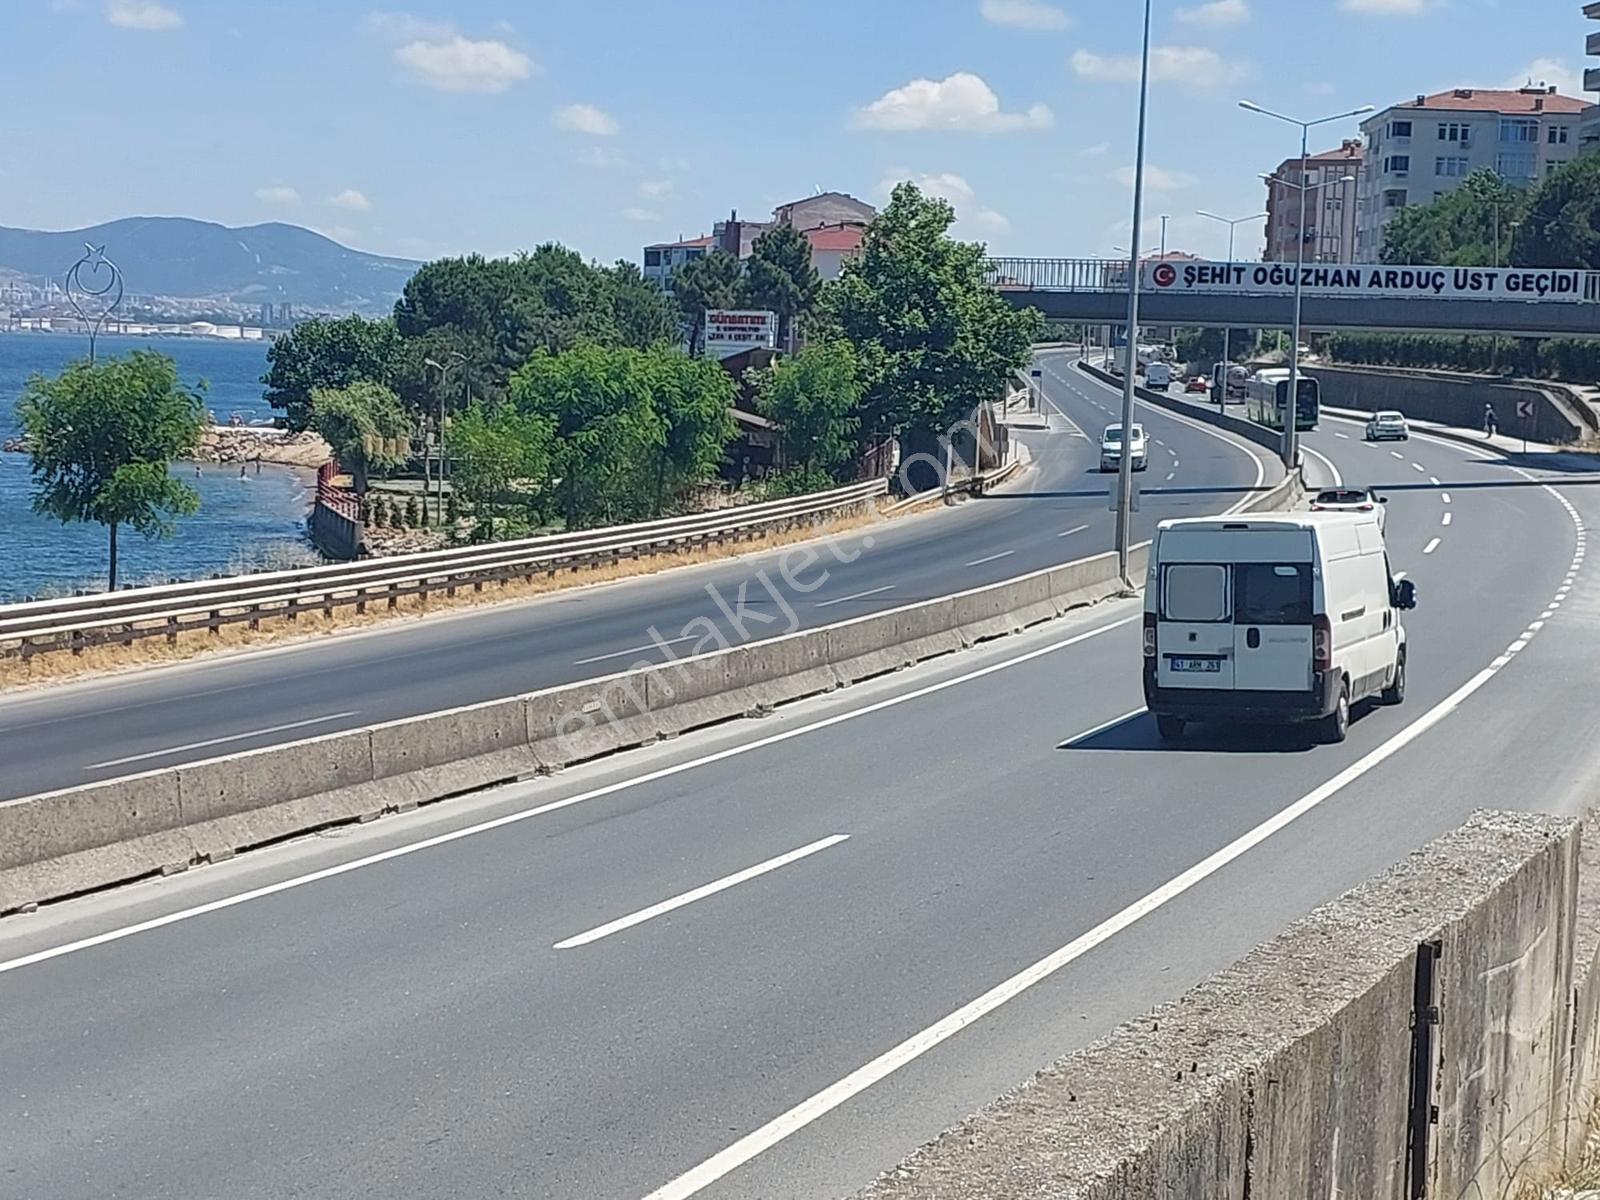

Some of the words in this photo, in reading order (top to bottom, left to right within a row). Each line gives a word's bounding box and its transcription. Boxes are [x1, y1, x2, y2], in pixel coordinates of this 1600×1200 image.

[1183, 263, 1246, 288] ŞEHİT
[1253, 264, 1361, 288] OĞUZHAN
[1367, 270, 1446, 294] ARDUÇ
[1505, 271, 1579, 297] GEÇİDİ
